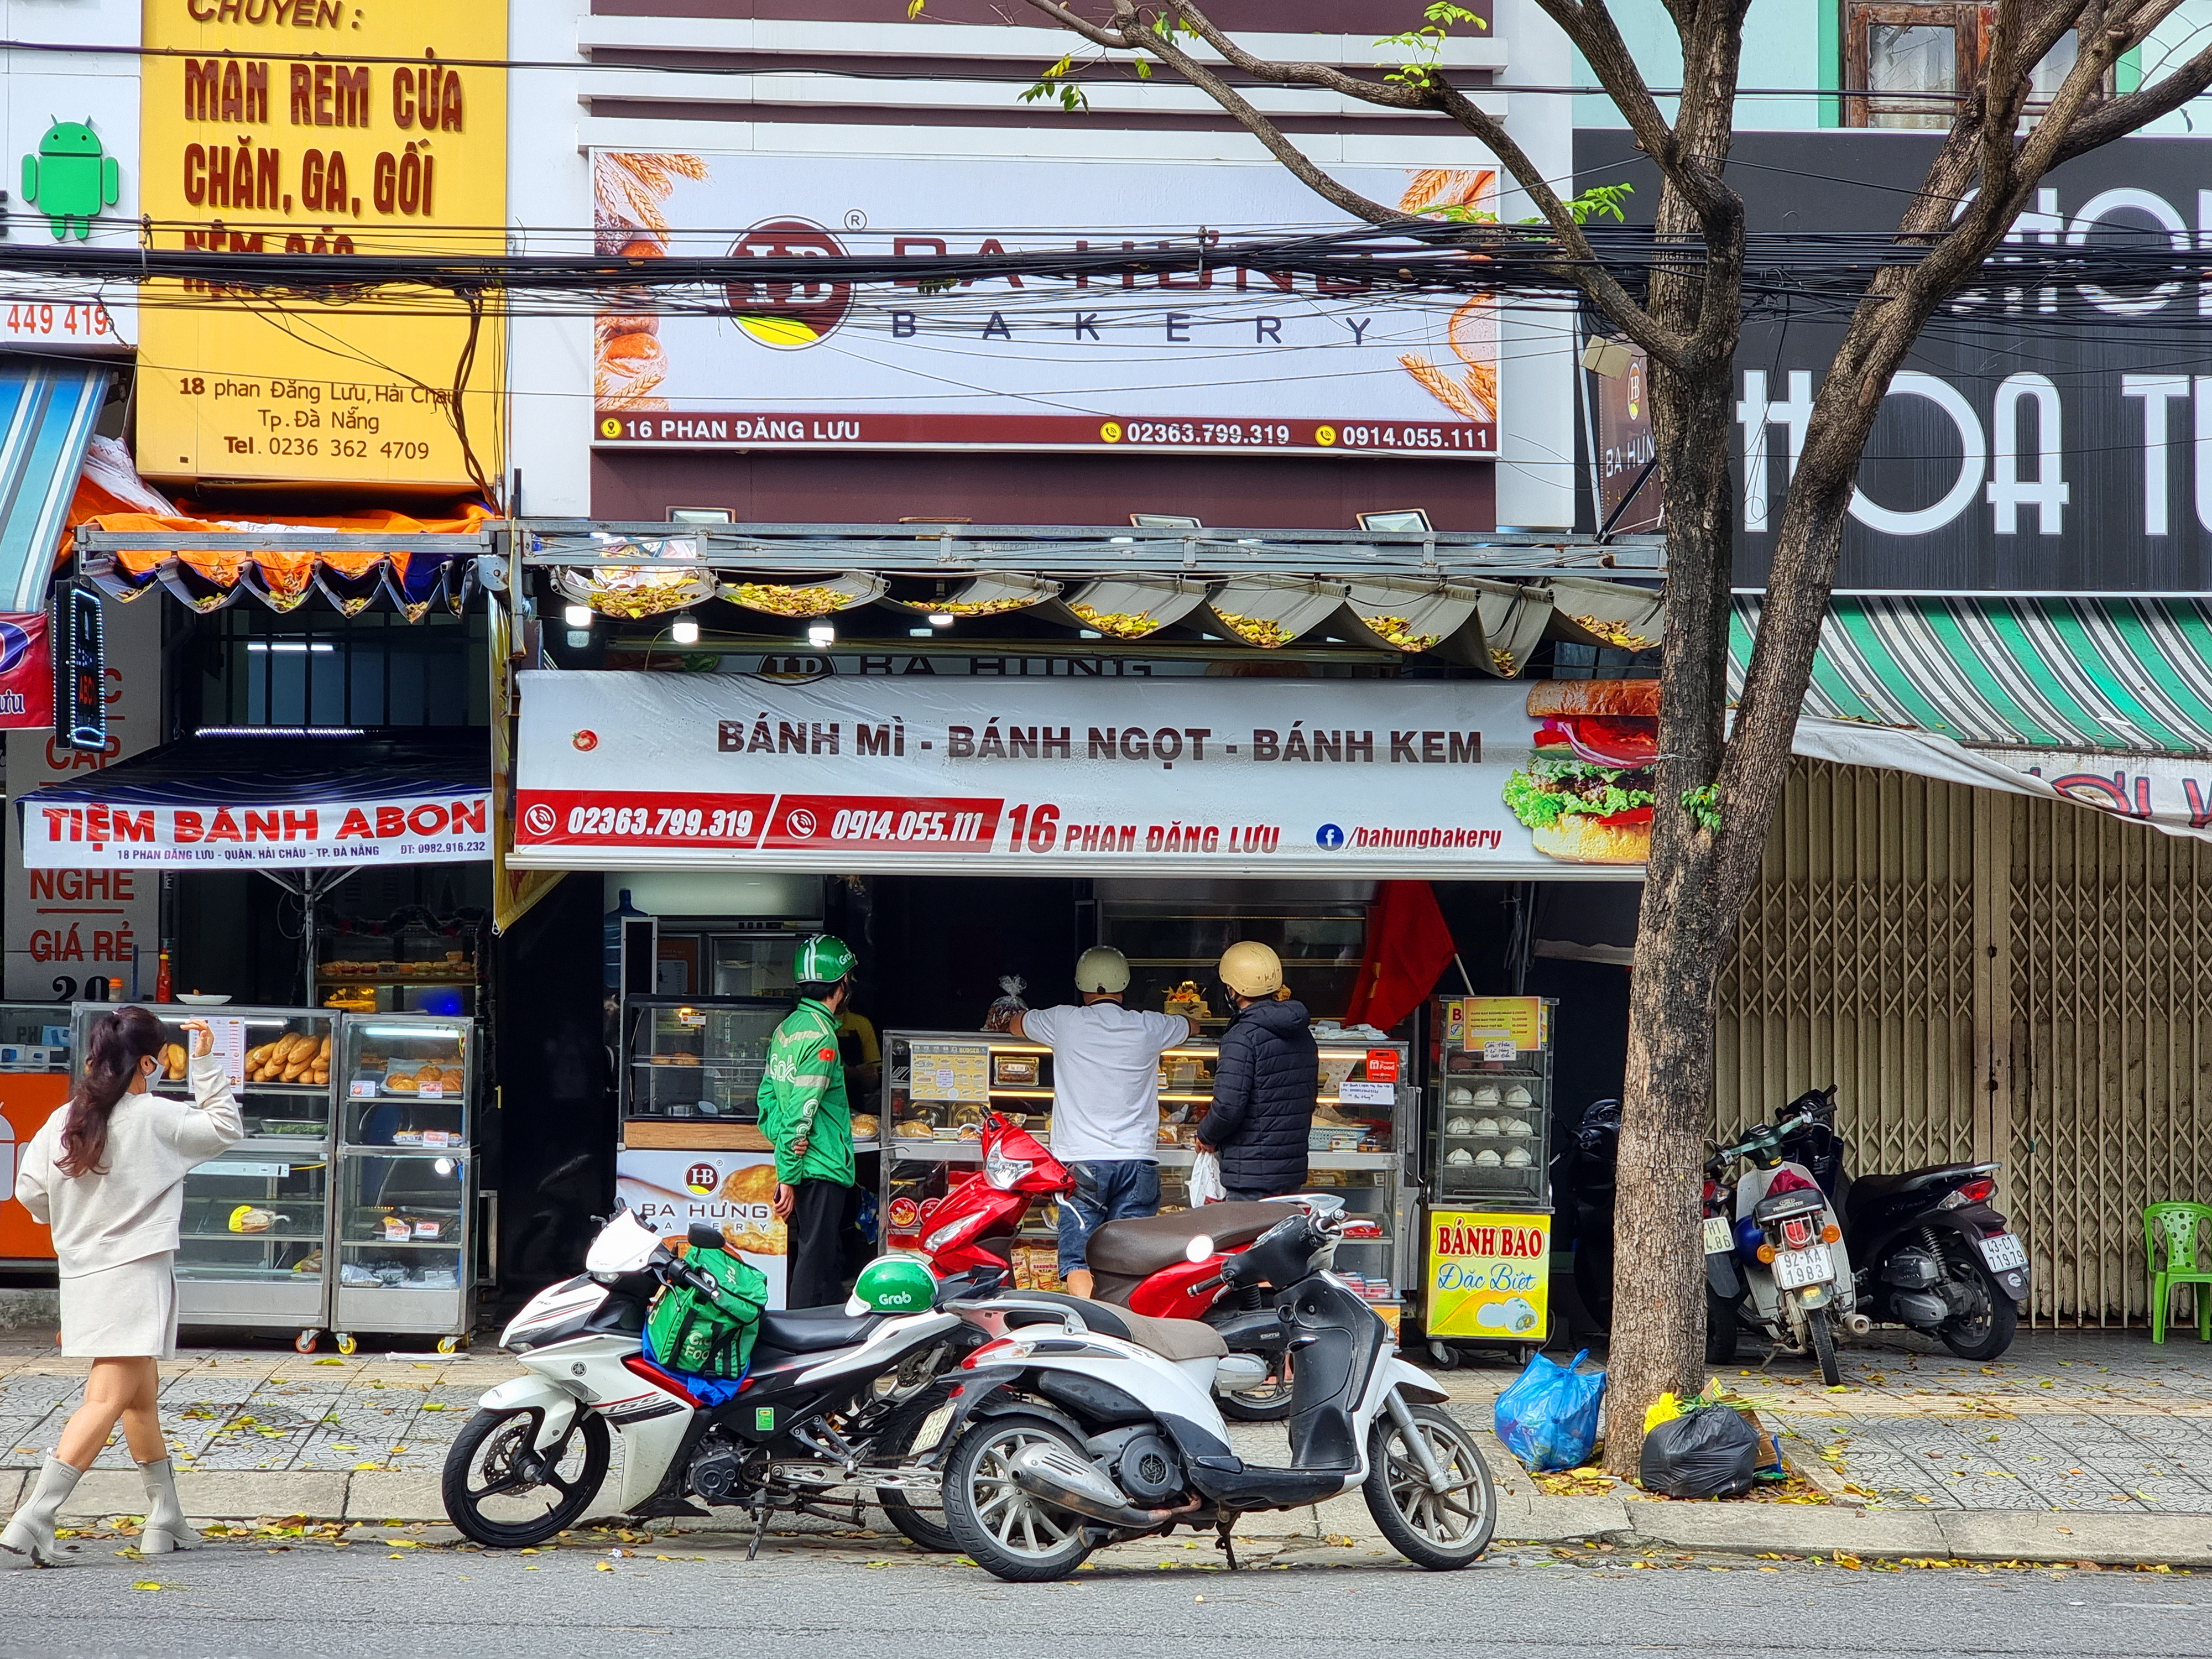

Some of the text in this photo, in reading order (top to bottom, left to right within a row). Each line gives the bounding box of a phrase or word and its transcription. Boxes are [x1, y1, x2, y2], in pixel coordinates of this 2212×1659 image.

[393, 47, 462, 131] CỬA
[185, 135, 432, 217] CHĂN, GA, GỐI
[7, 304, 108, 335] 449 419
[894, 310, 1371, 345] BAKERY
[180, 378, 205, 394] 18
[214, 379, 260, 399] phan
[270, 380, 320, 403] Đăng
[375, 383, 403, 402] Hải
[294, 410, 320, 427] Đà
[331, 406, 379, 434] Nẵng
[626, 416, 1487, 448] 16 PHAN ĐĂNG LƯU 02363.799.319 0914.055.111
[224, 436, 429, 459] Tel. 0236 362 4709
[1606, 428, 1656, 478] BA HƯN
[1736, 370, 2212, 536] HOA T
[718, 713, 839, 754] BÁNH
[857, 714, 905, 757] MÌ
[948, 717, 1072, 759] BÁNH
[1088, 726, 1212, 770] NGỌT
[1253, 720, 1373, 763] BÁNH
[1390, 731, 1481, 764] KEM
[42, 800, 487, 852] TIỆM BÁNH ABON
[568, 804, 1501, 854] 02363.799.319 0914.055.111 16 PHAN ĐĂNG LƯU /bahungbakery
[117, 850, 129, 859] 18
[133, 849, 160, 860] PHAN
[164, 847, 192, 860] ĐĂNG
[195, 848, 215, 860] LƯU
[258, 846, 275, 859] HẢI
[278, 847, 306, 859] CHÂU
[316, 848, 330, 858] TP.
[333, 846, 347, 858] ĐÀ
[351, 844, 379, 857] NẴNG
[400, 844, 414, 855] ĐT:
[418, 842, 486, 854] 0982.916.232
[30, 921, 133, 962] GIÁ RẺ
[642, 1202, 768, 1218] BA HƯNG
[1438, 1219, 1542, 1256] BÁNH BAO
[1988, 1237, 2014, 1254] 43-C1
[1785, 1248, 1822, 1268] 92-KA
[1989, 1250, 2025, 1270] 719.79
[1438, 1263, 1536, 1292] Đặc Biệt
[1787, 1264, 1824, 1285] 1983
[879, 1291, 911, 1305] Grab
